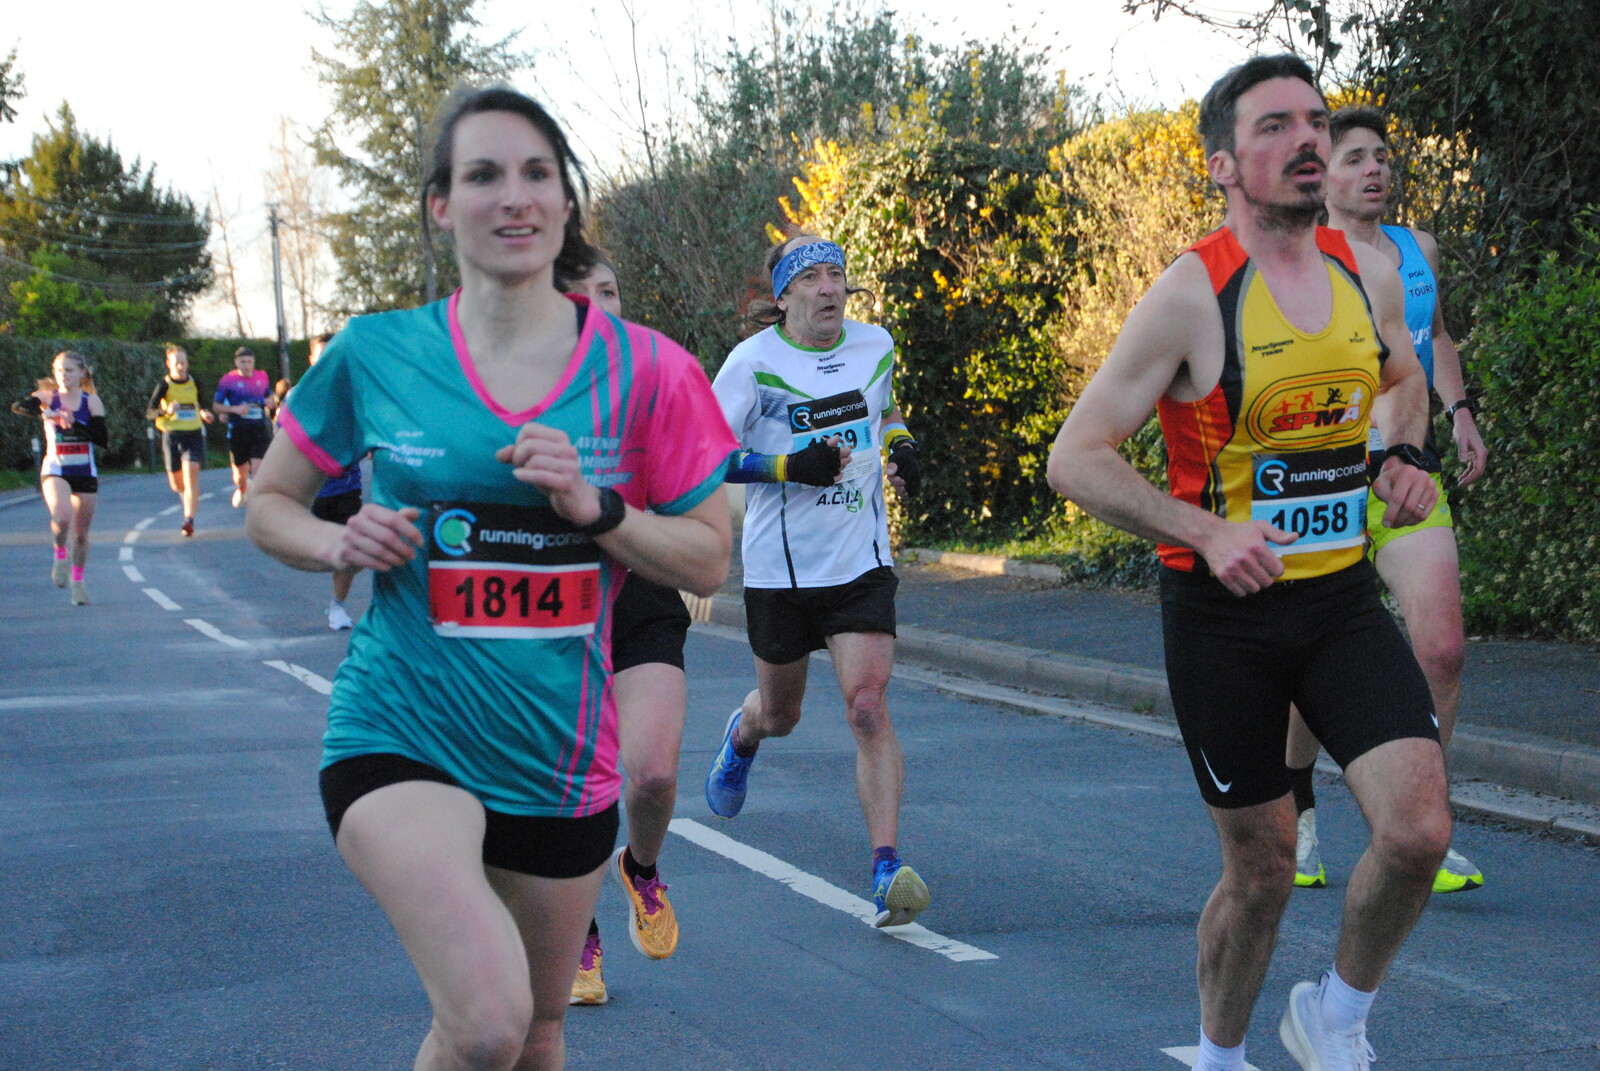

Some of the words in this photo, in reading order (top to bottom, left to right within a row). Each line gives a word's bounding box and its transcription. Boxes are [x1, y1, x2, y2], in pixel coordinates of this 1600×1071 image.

[1408, 284, 1434, 298] TOURS
[1268, 404, 1360, 433] SPMA
[1271, 501, 1348, 539] 1058
[455, 576, 563, 618] 1814
